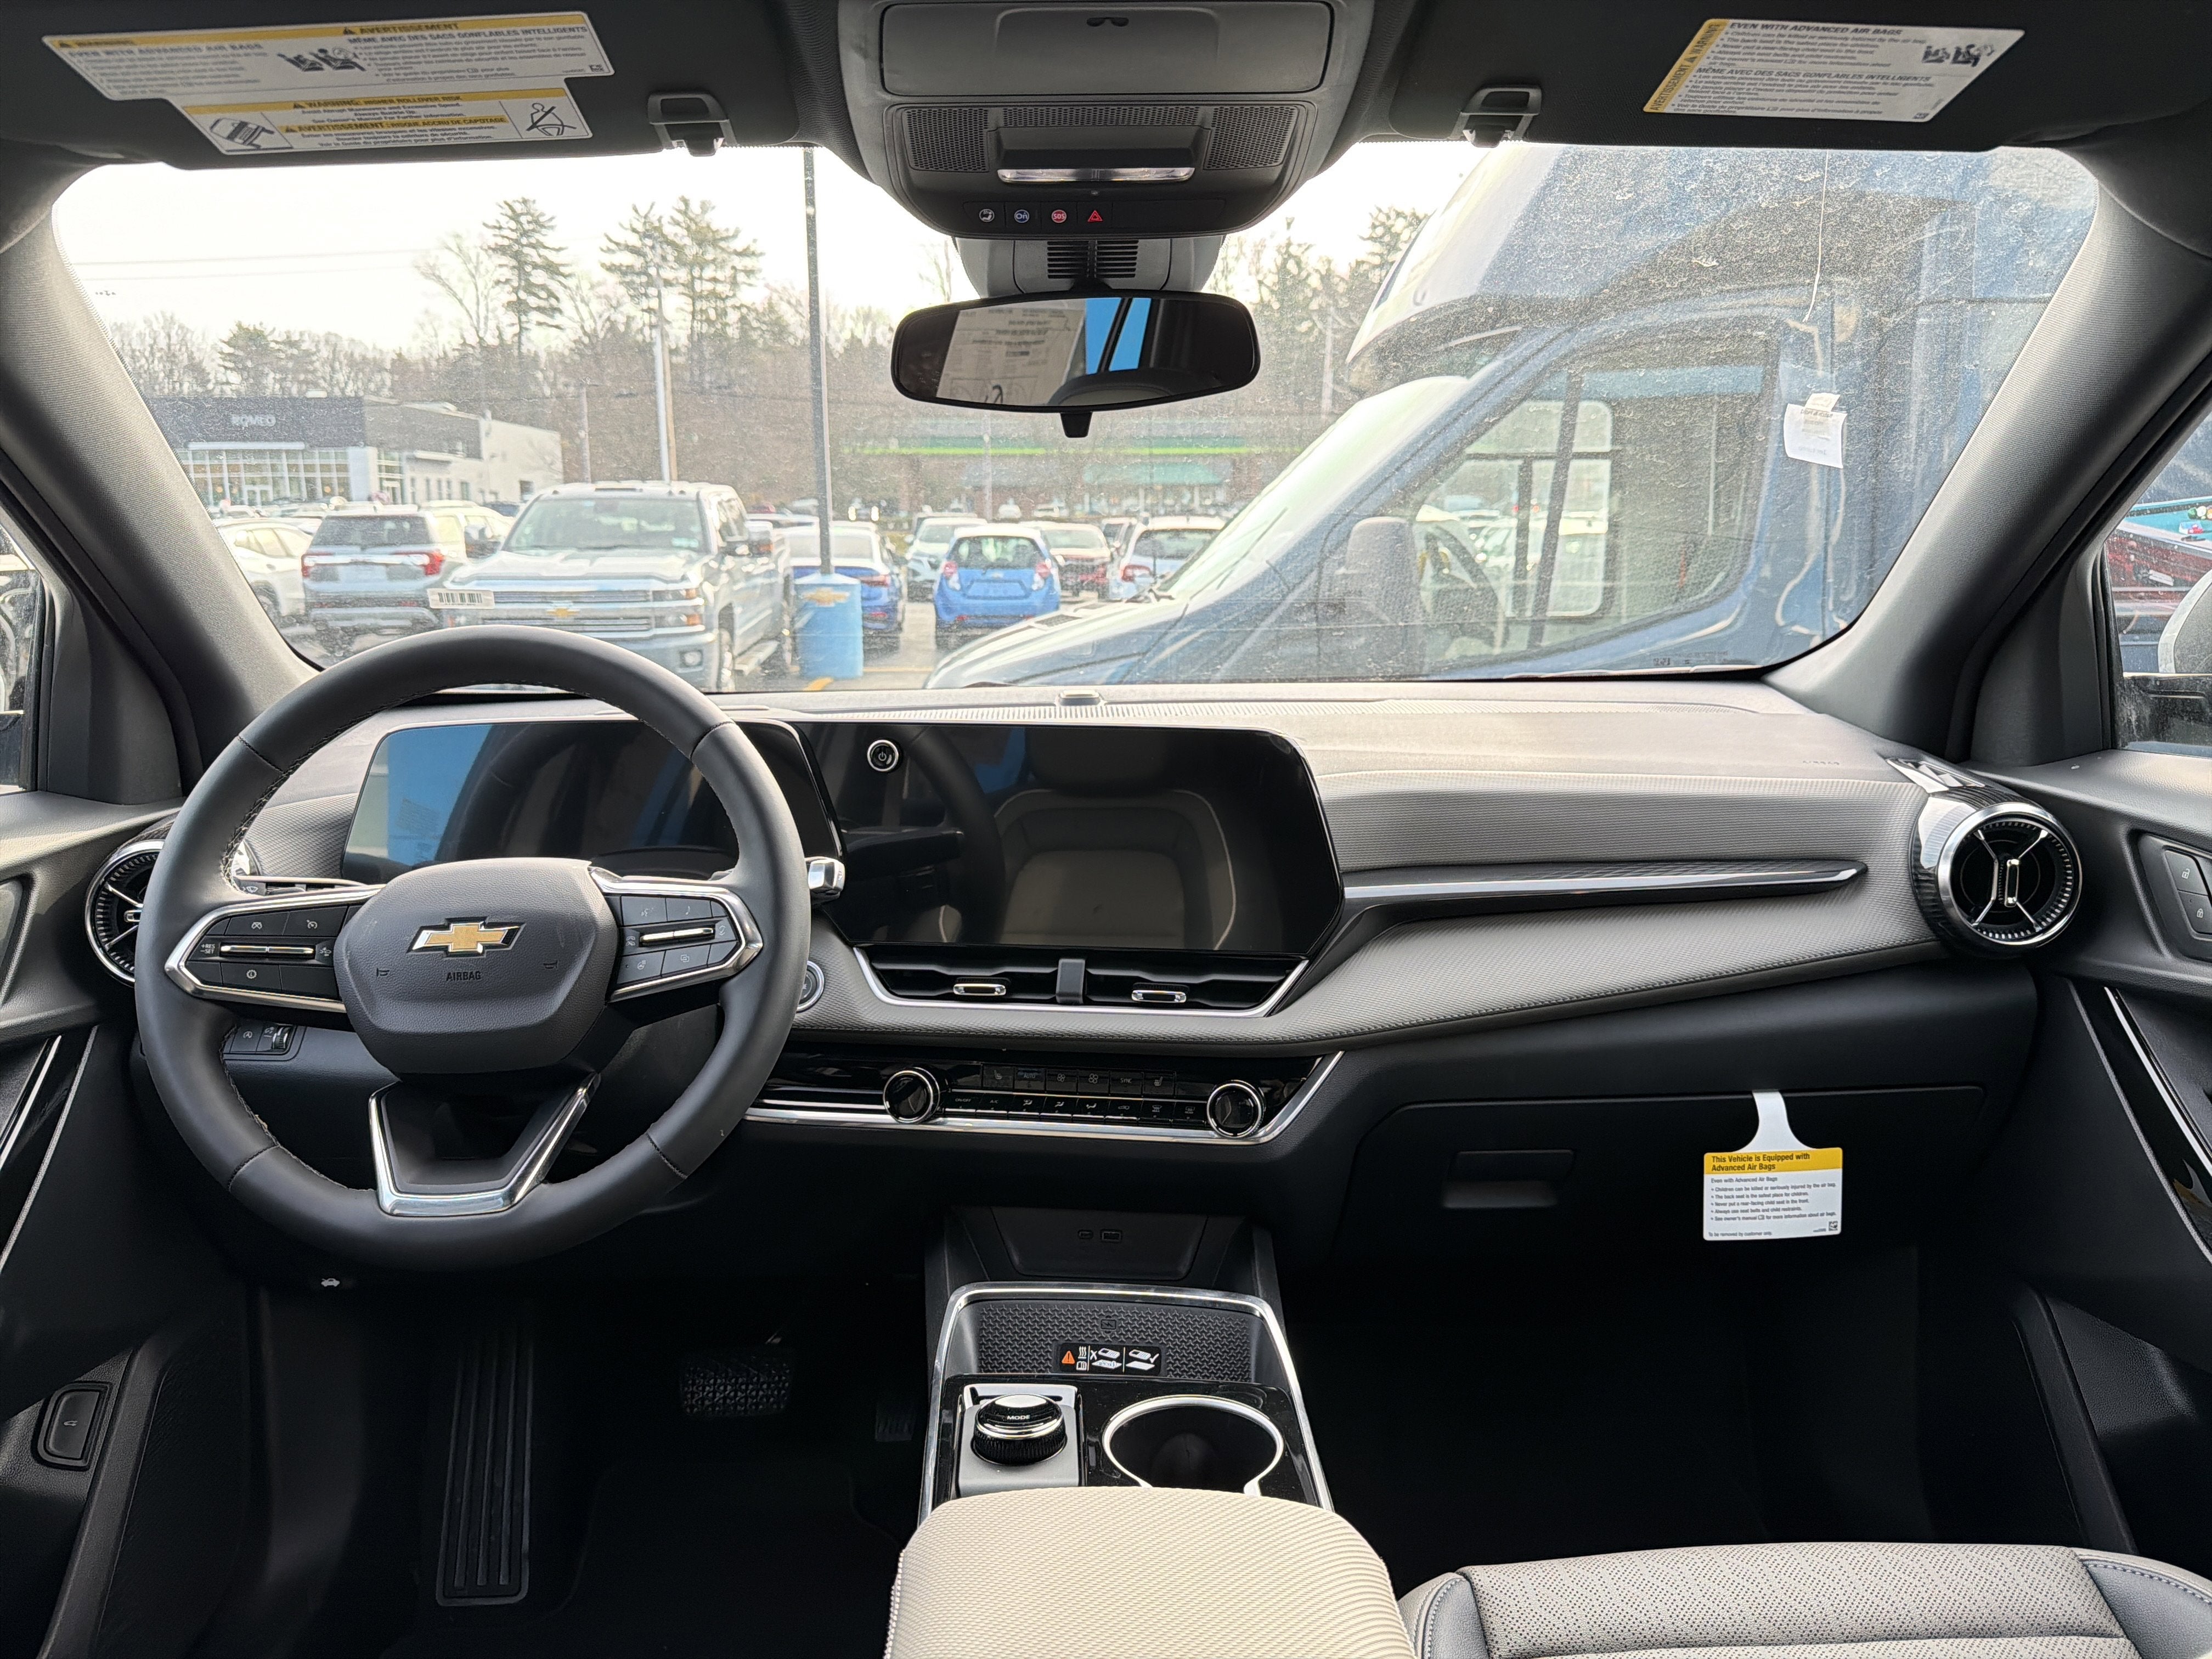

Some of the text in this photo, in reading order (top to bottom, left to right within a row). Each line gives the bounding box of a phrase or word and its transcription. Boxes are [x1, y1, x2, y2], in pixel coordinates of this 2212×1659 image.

[458, 29, 520, 38] GONFLABLES
[522, 26, 588, 35] INTELLIGENTS
[1790, 25, 1849, 33] ADVANCED
[231, 414, 276, 426] ROMEO
[446, 970, 481, 981] AIRBAG
[1728, 1154, 1753, 1163] Vehicle
[1763, 1153, 1793, 1162] Equipped
[1759, 1163, 1776, 1171] Bags
